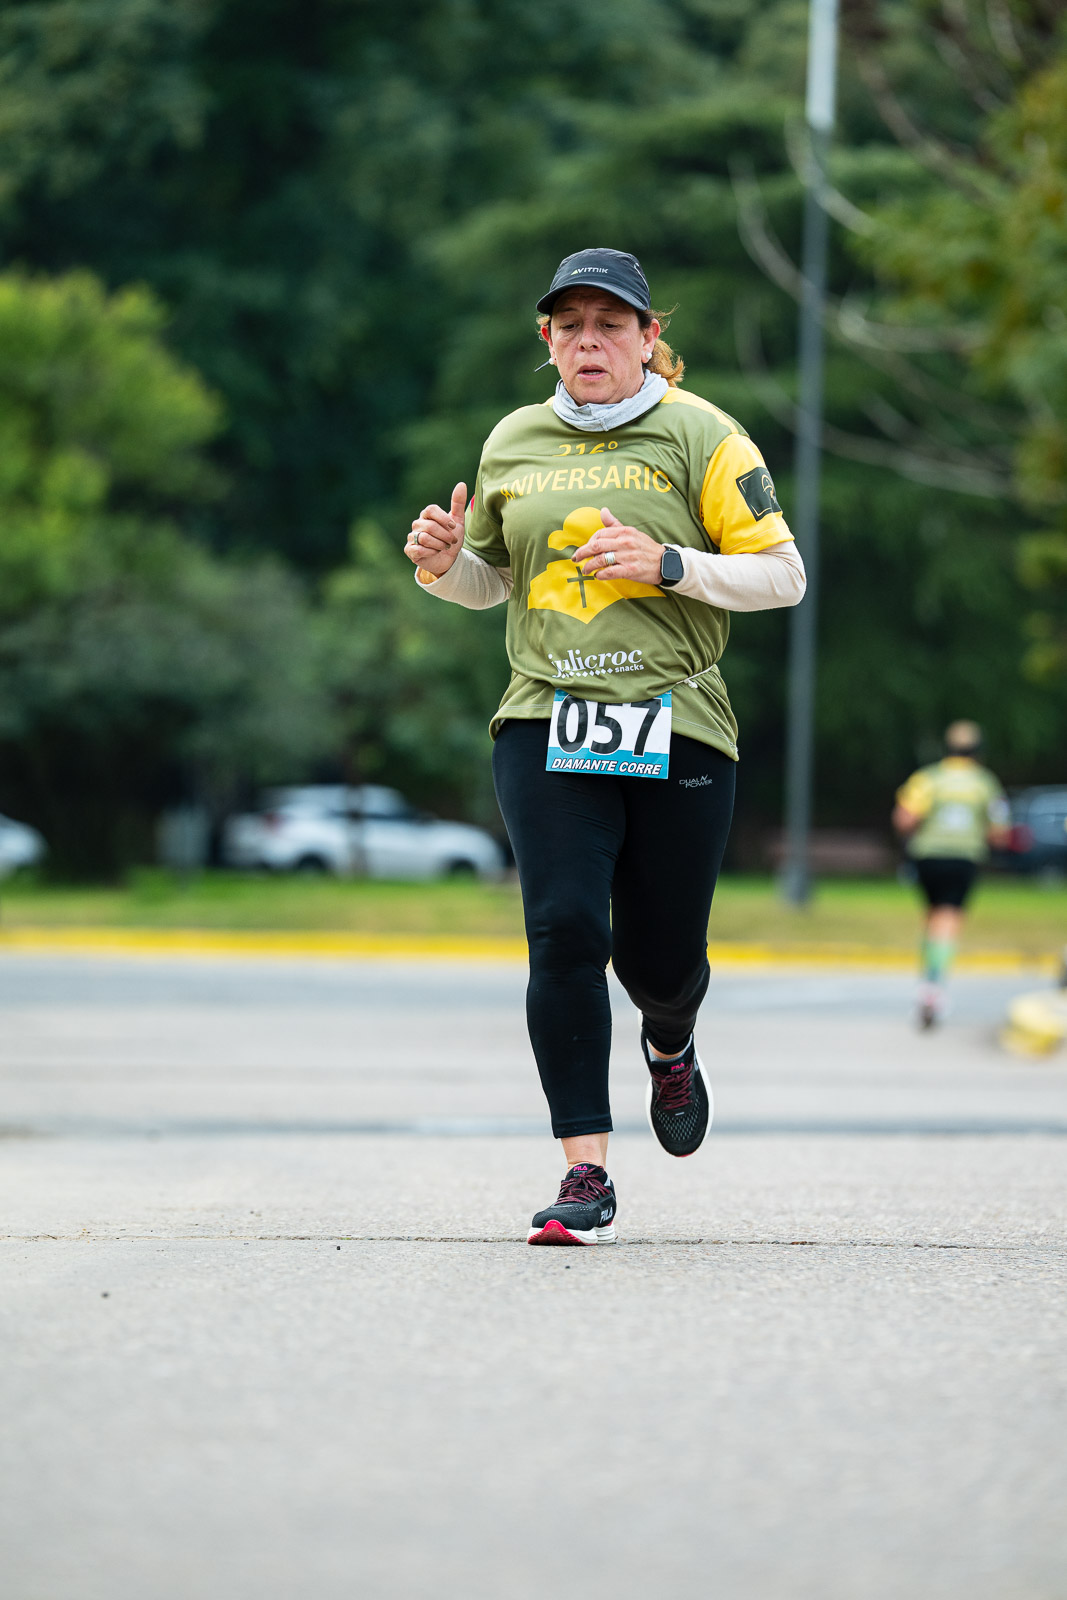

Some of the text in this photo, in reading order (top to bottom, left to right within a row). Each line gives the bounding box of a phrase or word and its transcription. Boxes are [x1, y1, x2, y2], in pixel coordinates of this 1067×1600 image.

[500, 465, 673, 504] ANIVERSARIO
[547, 649, 643, 679] julicroc
[614, 663, 645, 674] snacks
[556, 694, 663, 757] 057
[551, 758, 663, 776] DIAMANTE CORRE
